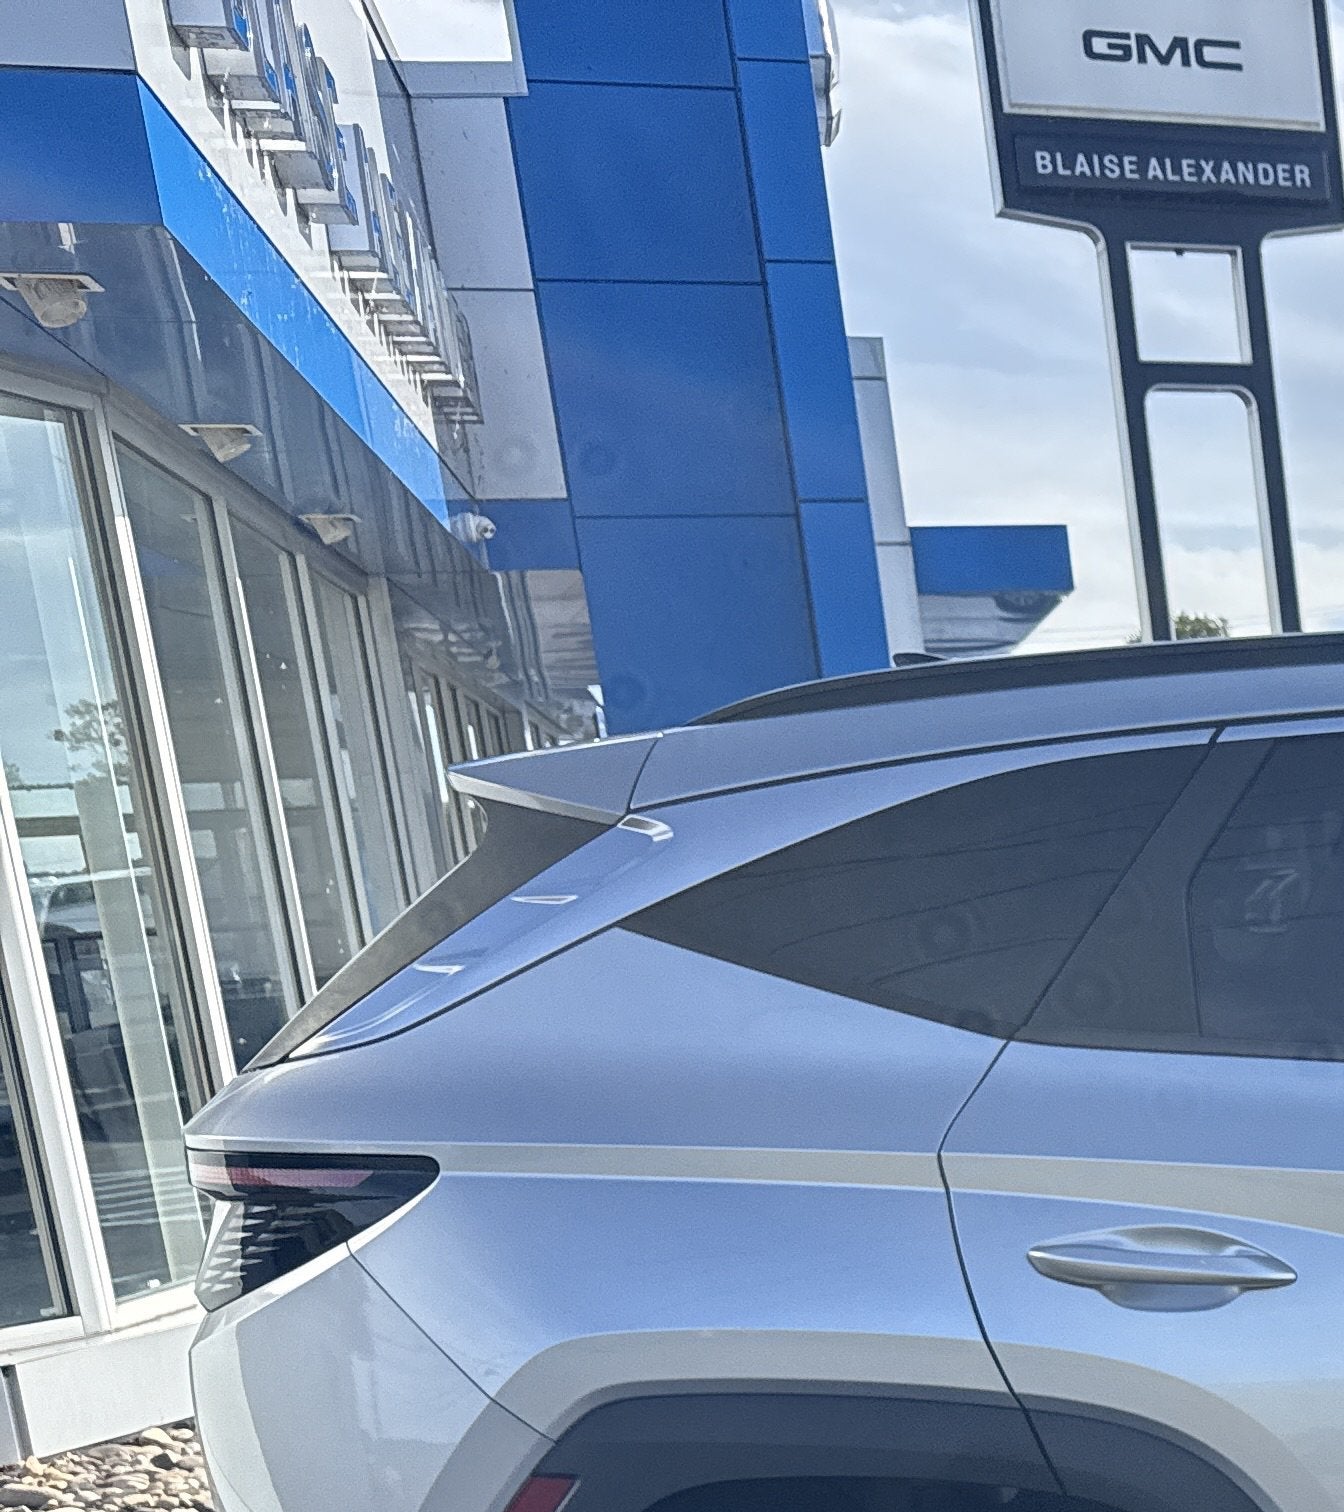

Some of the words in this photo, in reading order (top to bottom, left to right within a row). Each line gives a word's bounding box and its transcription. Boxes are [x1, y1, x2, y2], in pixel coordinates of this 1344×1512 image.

[1082, 29, 1243, 72] GMC
[1035, 150, 1138, 180] BLAISE
[1147, 157, 1312, 188] ALEXANDER
